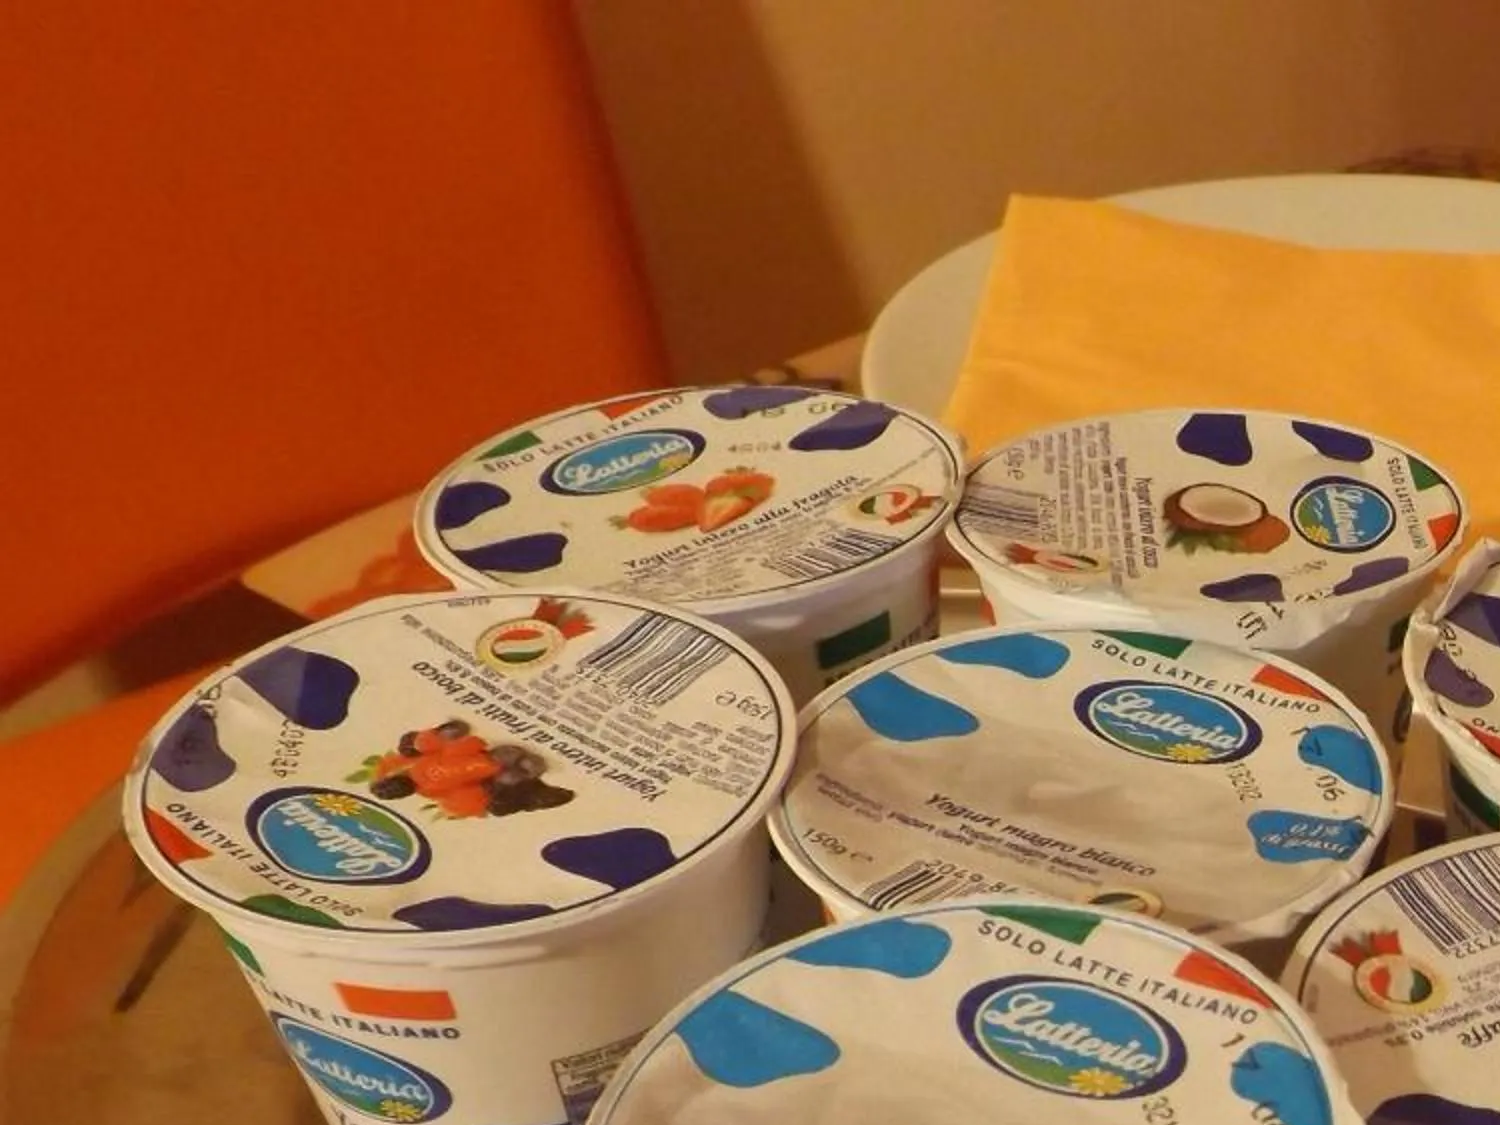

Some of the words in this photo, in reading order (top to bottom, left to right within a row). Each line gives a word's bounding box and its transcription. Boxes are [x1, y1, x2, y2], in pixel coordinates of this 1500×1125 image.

[540, 431, 598, 456] LATTE
[602, 395, 684, 434] ITALIANO
[623, 544, 690, 576] Yogurt
[691, 523, 748, 547] intero
[754, 507, 790, 525] alla
[792, 475, 861, 509] fragola
[411, 661, 465, 701] bosco
[455, 689, 484, 705] di
[1091, 638, 1147, 669] SOLO
[1152, 660, 1217, 692] LATTE
[1221, 682, 1322, 714] ITALIANO
[476, 703, 534, 734] frutti
[524, 724, 554, 743] ai
[1097, 690, 1241, 747] Latteria
[550, 741, 606, 773] intero
[601, 754, 666, 802] Yogurt
[166, 803, 252, 861] ITALIANO
[277, 800, 401, 873] Latteria
[925, 793, 1000, 828] Yogurt
[1001, 825, 1077, 853] magro
[1078, 847, 1156, 876] bianco
[250, 860, 315, 898] LATTE
[977, 919, 1045, 961] SOLO
[1053, 945, 1132, 988] LATTE
[1140, 978, 1259, 1025] ITALIANO
[332, 1013, 461, 1041] ITALIANO
[986, 992, 1160, 1076] Latteria
[289, 1036, 428, 1101] Latteria
